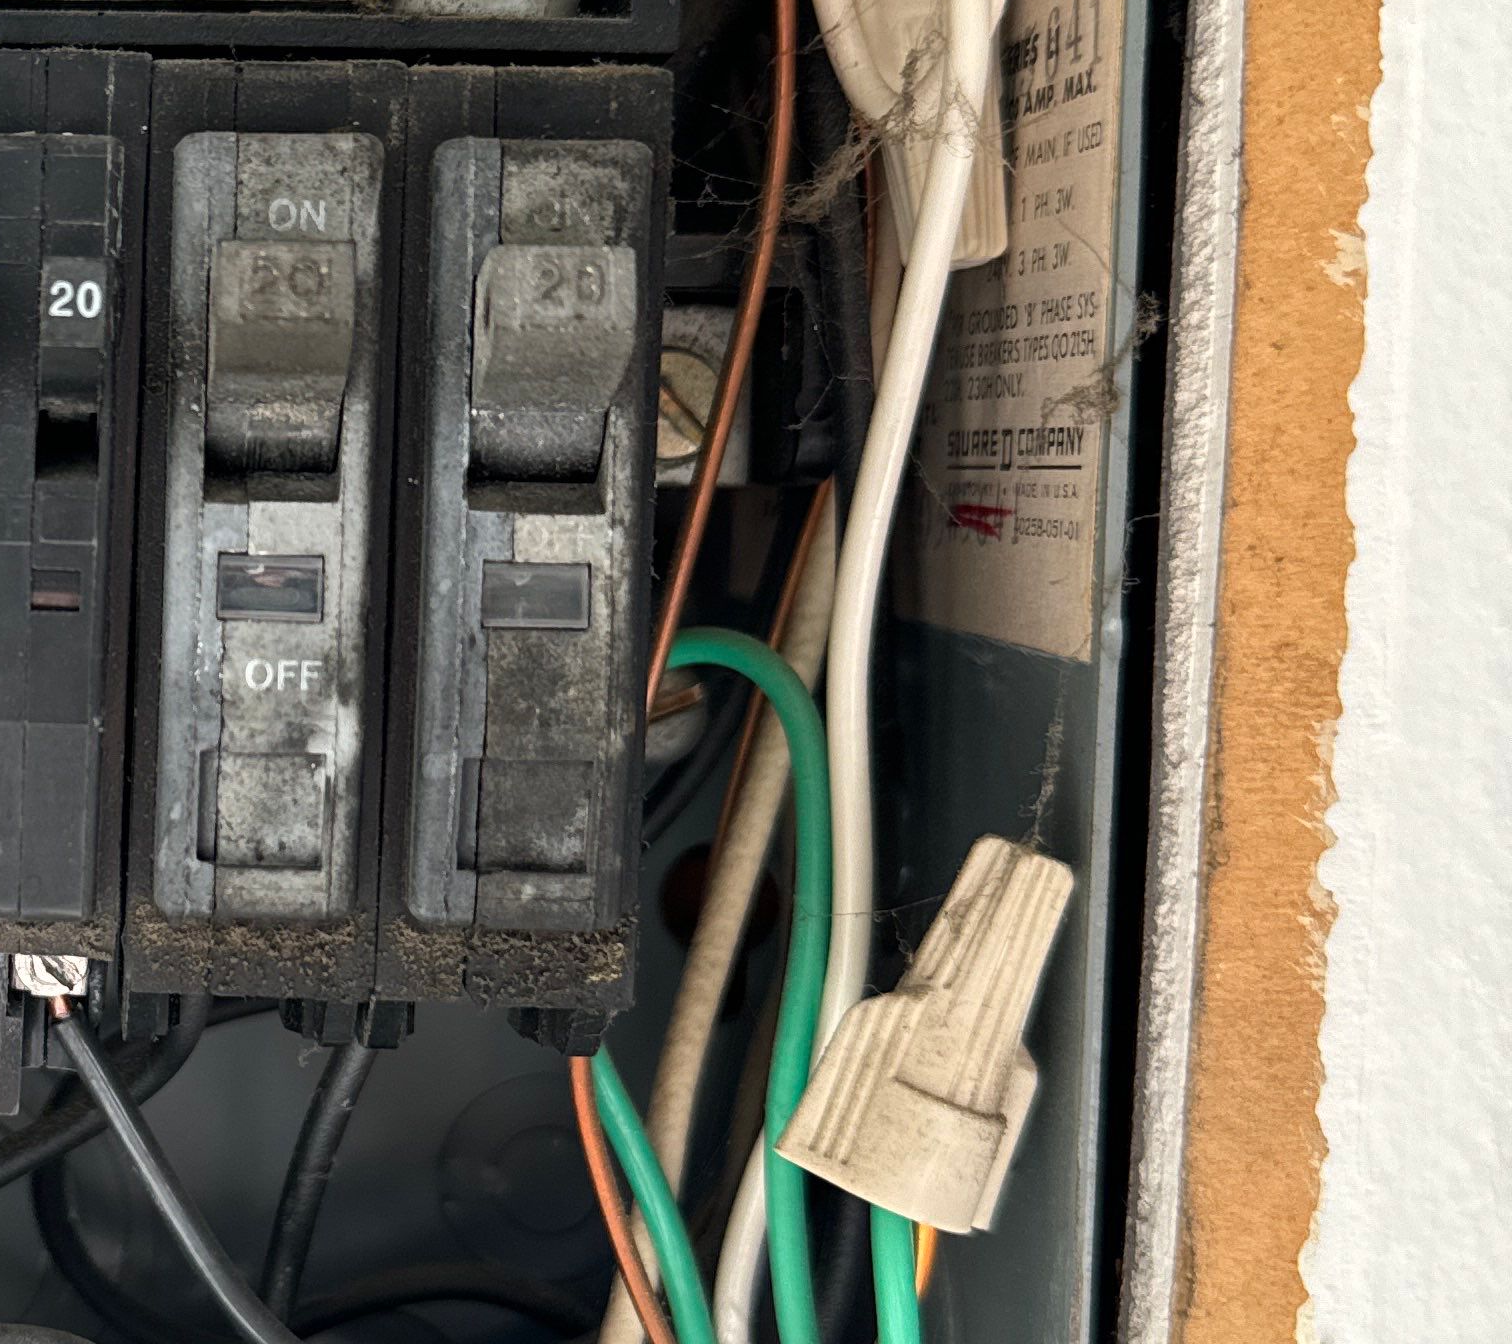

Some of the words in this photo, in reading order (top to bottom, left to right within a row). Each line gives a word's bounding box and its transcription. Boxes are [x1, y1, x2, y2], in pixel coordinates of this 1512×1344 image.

[1023, 84, 1057, 117] AMP.
[1062, 66, 1097, 104] MAX.
[1063, 130, 1073, 158] IF
[1077, 121, 1103, 154] USED
[268, 197, 327, 232] ON
[1021, 196, 1027, 223] 1
[1055, 185, 1076, 215] 3W.
[534, 259, 606, 306] 20
[1018, 250, 1026, 277] 3
[48, 280, 103, 319] 20
[968, 304, 1018, 336] GROUNDED
[1040, 294, 1073, 325] PHASE
[977, 337, 1021, 368] BREAKERS
[1023, 335, 1049, 363] TYPES
[947, 429, 998, 457] SQUARE
[999, 428, 1013, 471] D
[1017, 425, 1085, 456] COMPANY
[244, 659, 323, 692] OFF
